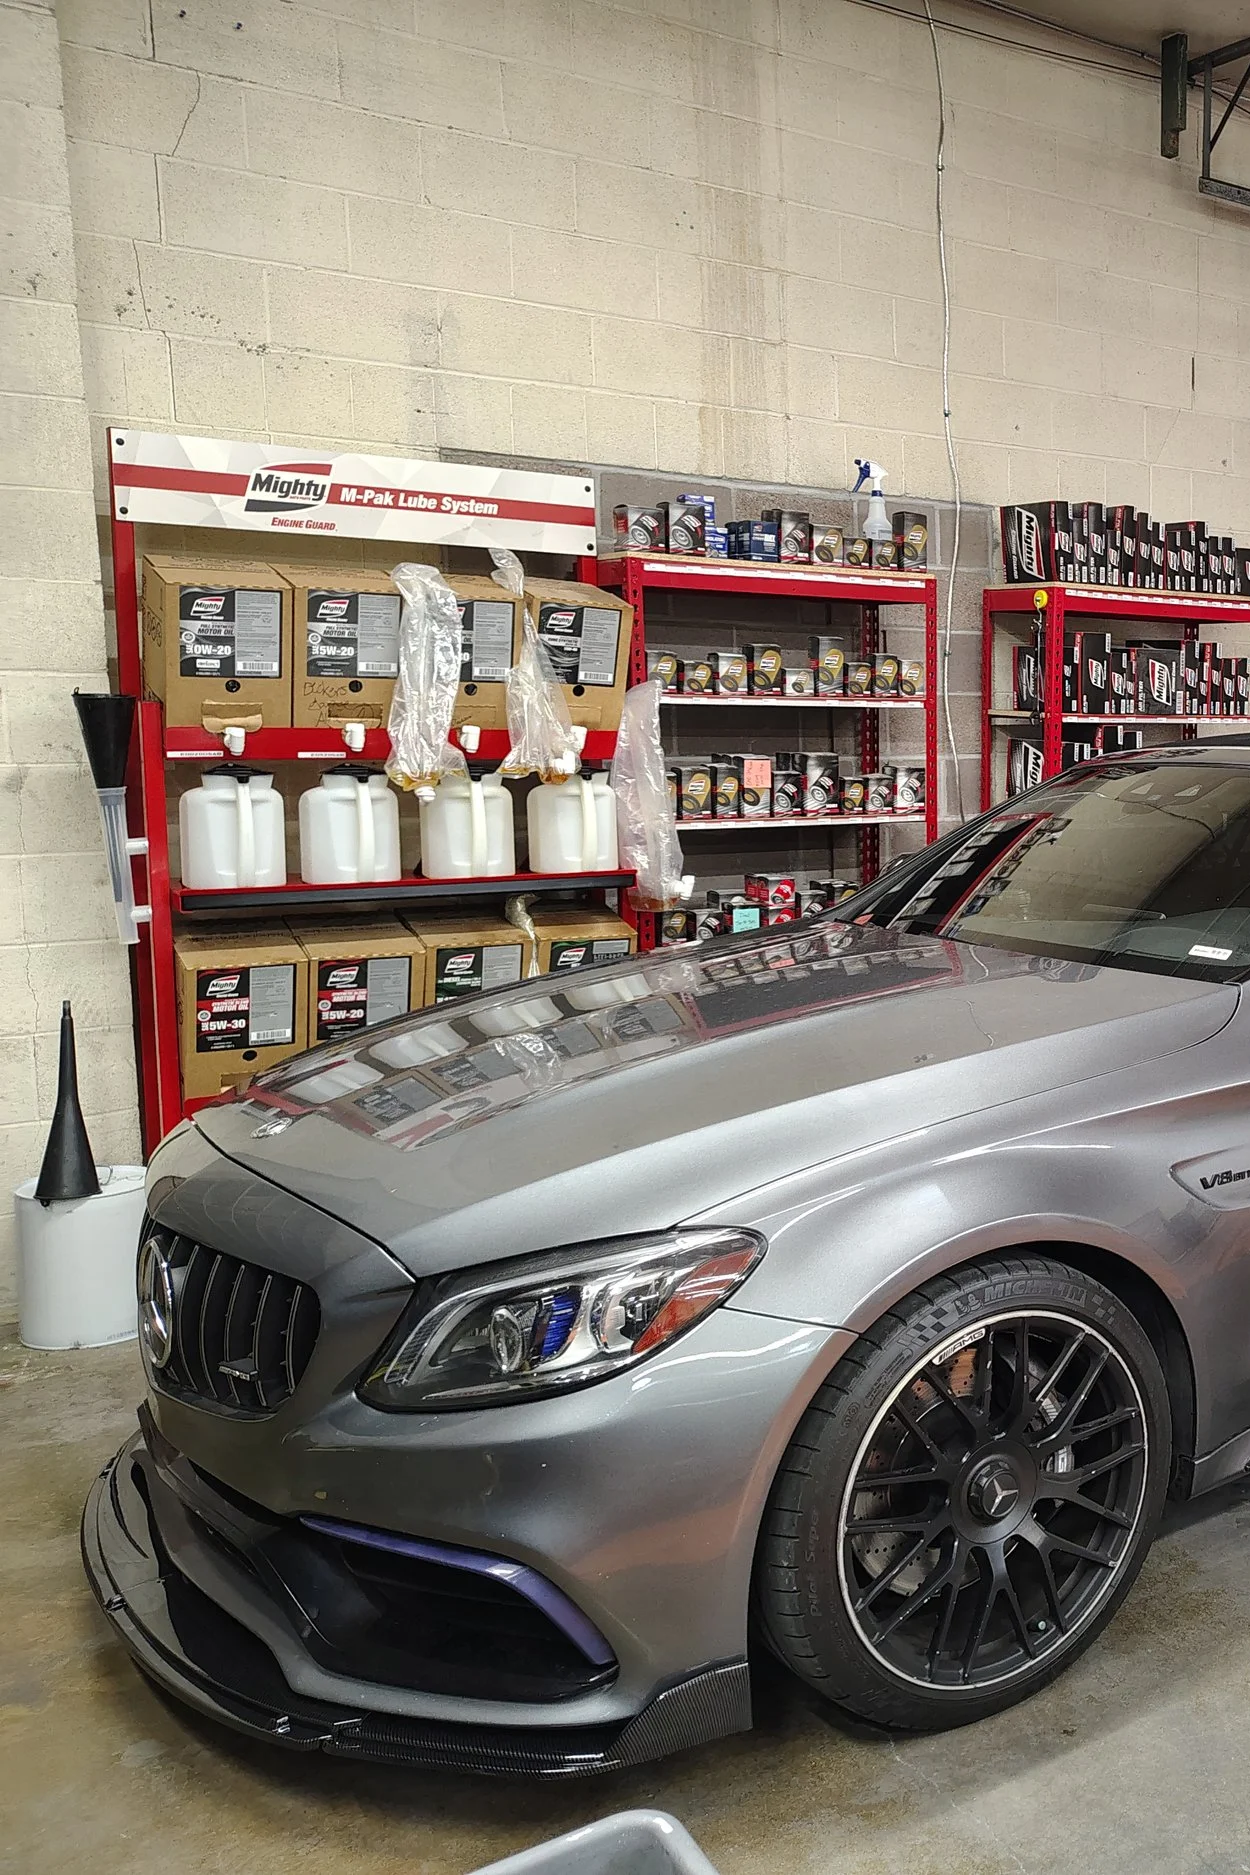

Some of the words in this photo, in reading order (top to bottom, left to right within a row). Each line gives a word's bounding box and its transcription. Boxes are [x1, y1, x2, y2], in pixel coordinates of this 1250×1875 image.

[251, 473, 327, 500] Mighty
[340, 487, 394, 506] M-Pak
[399, 492, 436, 510] Lube
[440, 498, 499, 516] System
[271, 517, 304, 528] ENGINE
[305, 519, 337, 532] GUARD
[1025, 514, 1035, 573] Mighty
[194, 602, 221, 610] Mighty
[321, 604, 346, 612] Mighty
[551, 615, 573, 625] Mighty
[194, 644, 232, 655] 0W-20
[319, 645, 355, 656] 5W-20
[1156, 664, 1165, 700] Mighty
[562, 952, 583, 960] Mighty
[450, 959, 471, 968] Mighty
[211, 981, 235, 989] Mighty
[329, 1009, 364, 1020] 5W-20
[210, 1019, 246, 1030] 5W-30
[1200, 1170, 1233, 1190] V8
[984, 1279, 1086, 1307] MICHELIN
